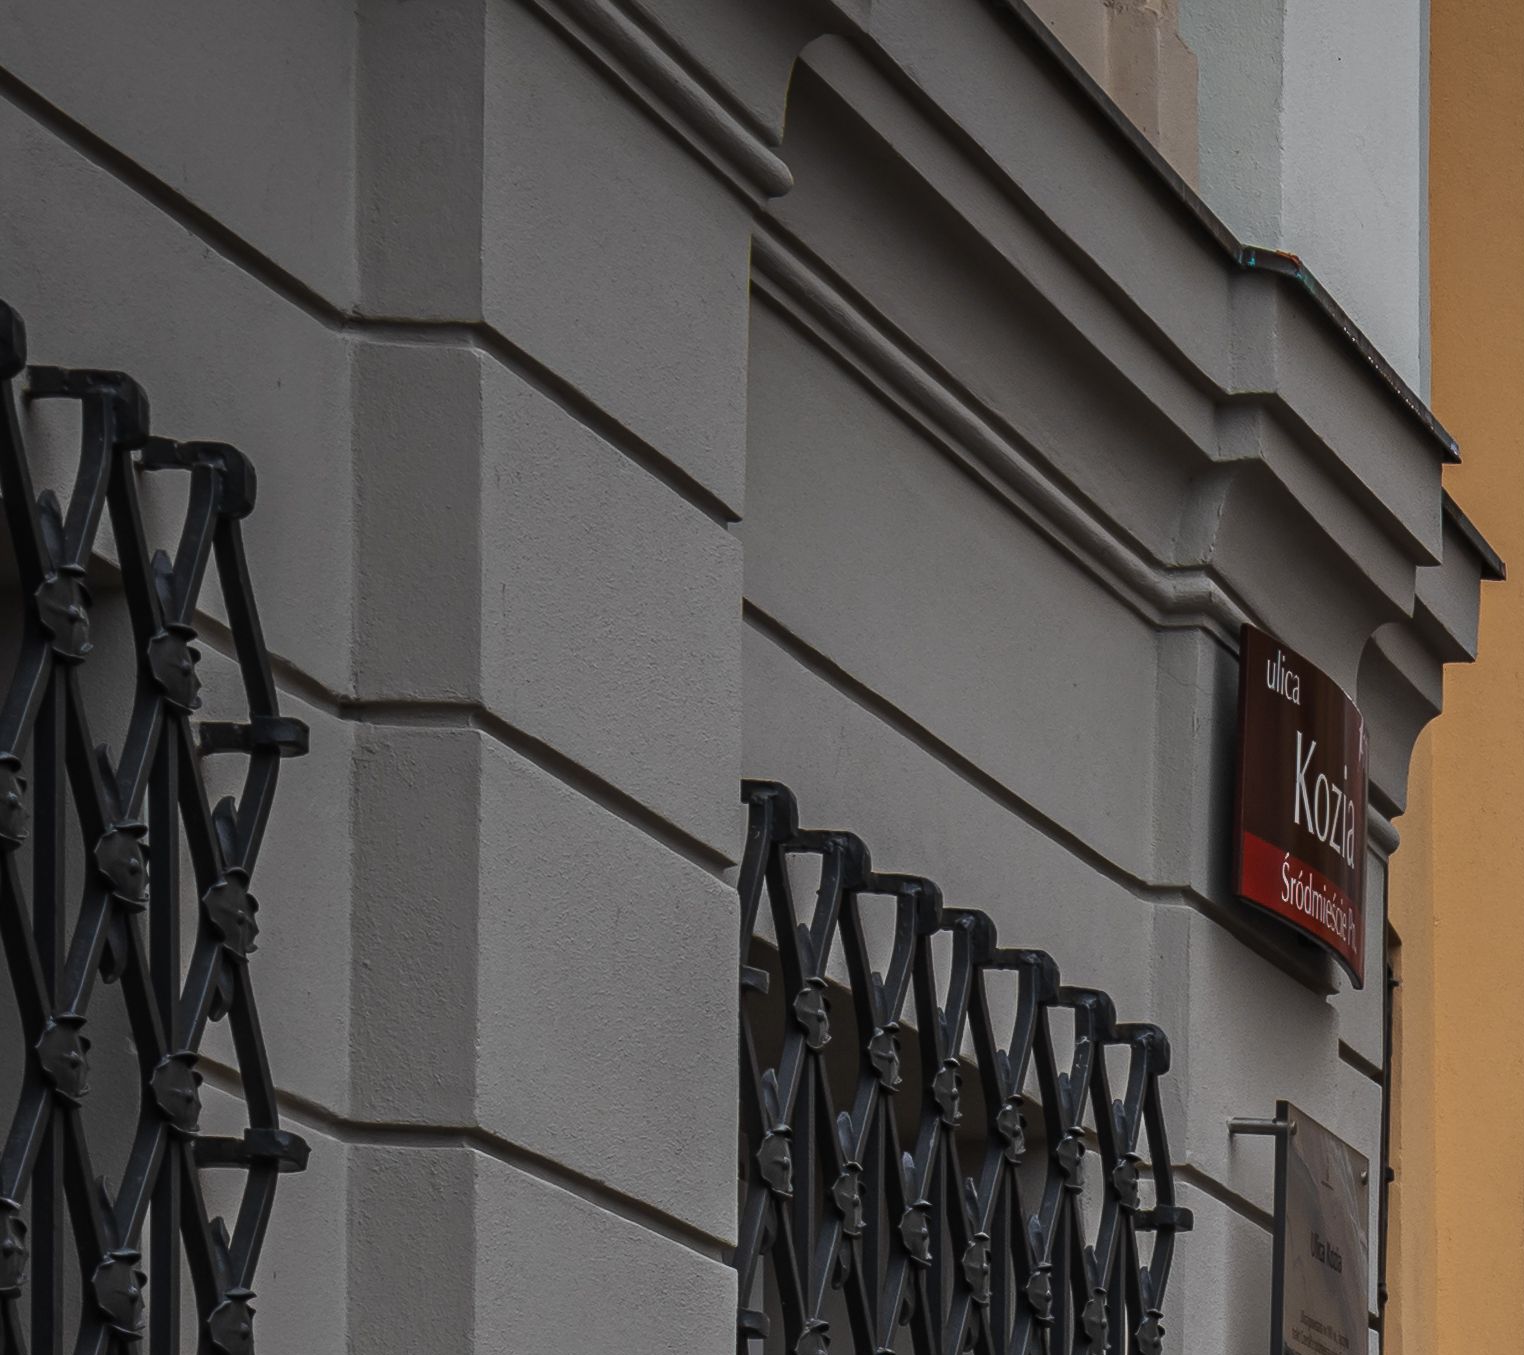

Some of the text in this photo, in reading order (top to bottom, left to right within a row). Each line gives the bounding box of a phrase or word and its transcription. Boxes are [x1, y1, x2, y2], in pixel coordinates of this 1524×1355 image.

[1266, 648, 1301, 705] ulica
[1294, 729, 1355, 870] Kozia
[1281, 851, 1347, 942] Śródmieście
